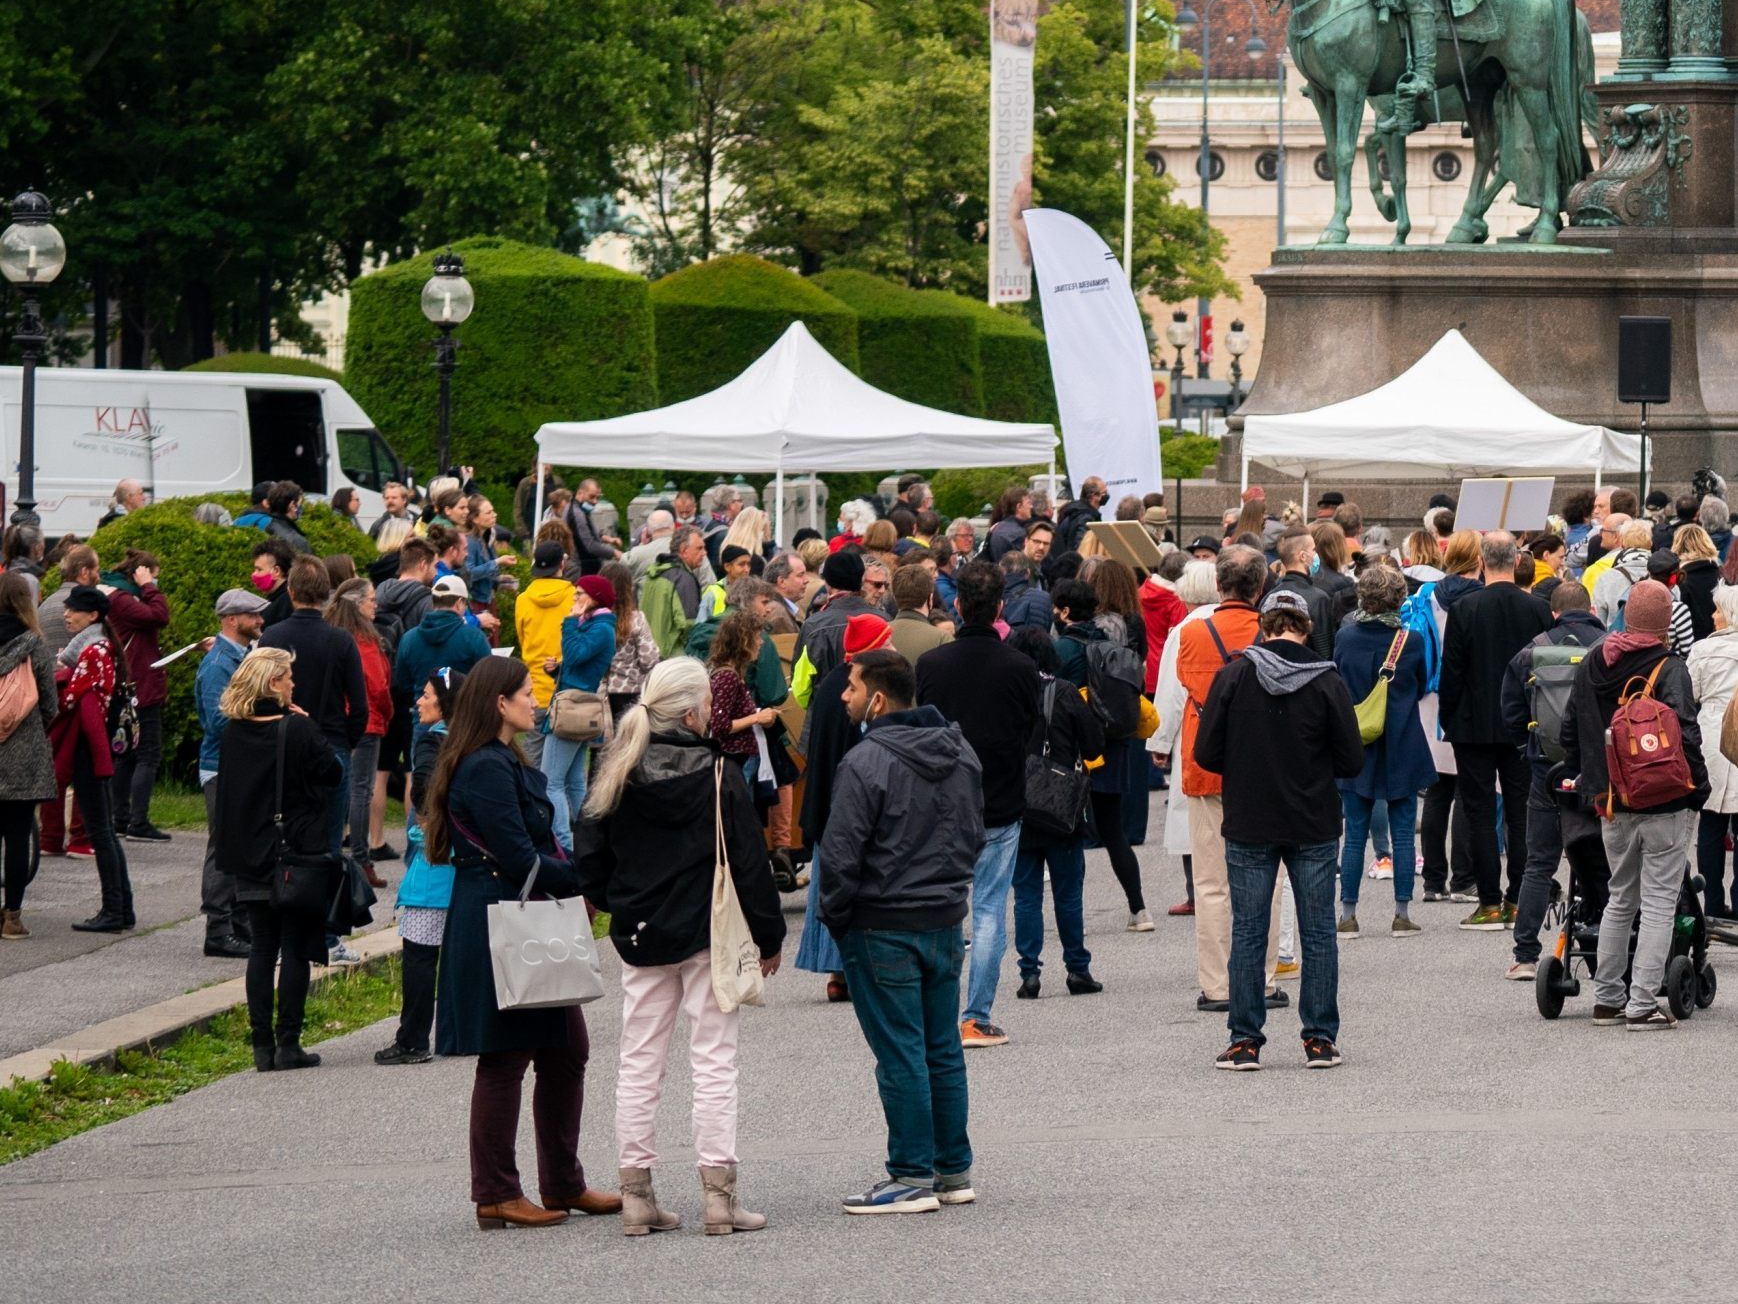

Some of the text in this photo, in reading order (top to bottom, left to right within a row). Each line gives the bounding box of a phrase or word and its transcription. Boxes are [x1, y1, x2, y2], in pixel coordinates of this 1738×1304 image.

[996, 56, 1014, 252] naturhistorisches
[1014, 57, 1029, 155] museum
[519, 934, 591, 966] COS
